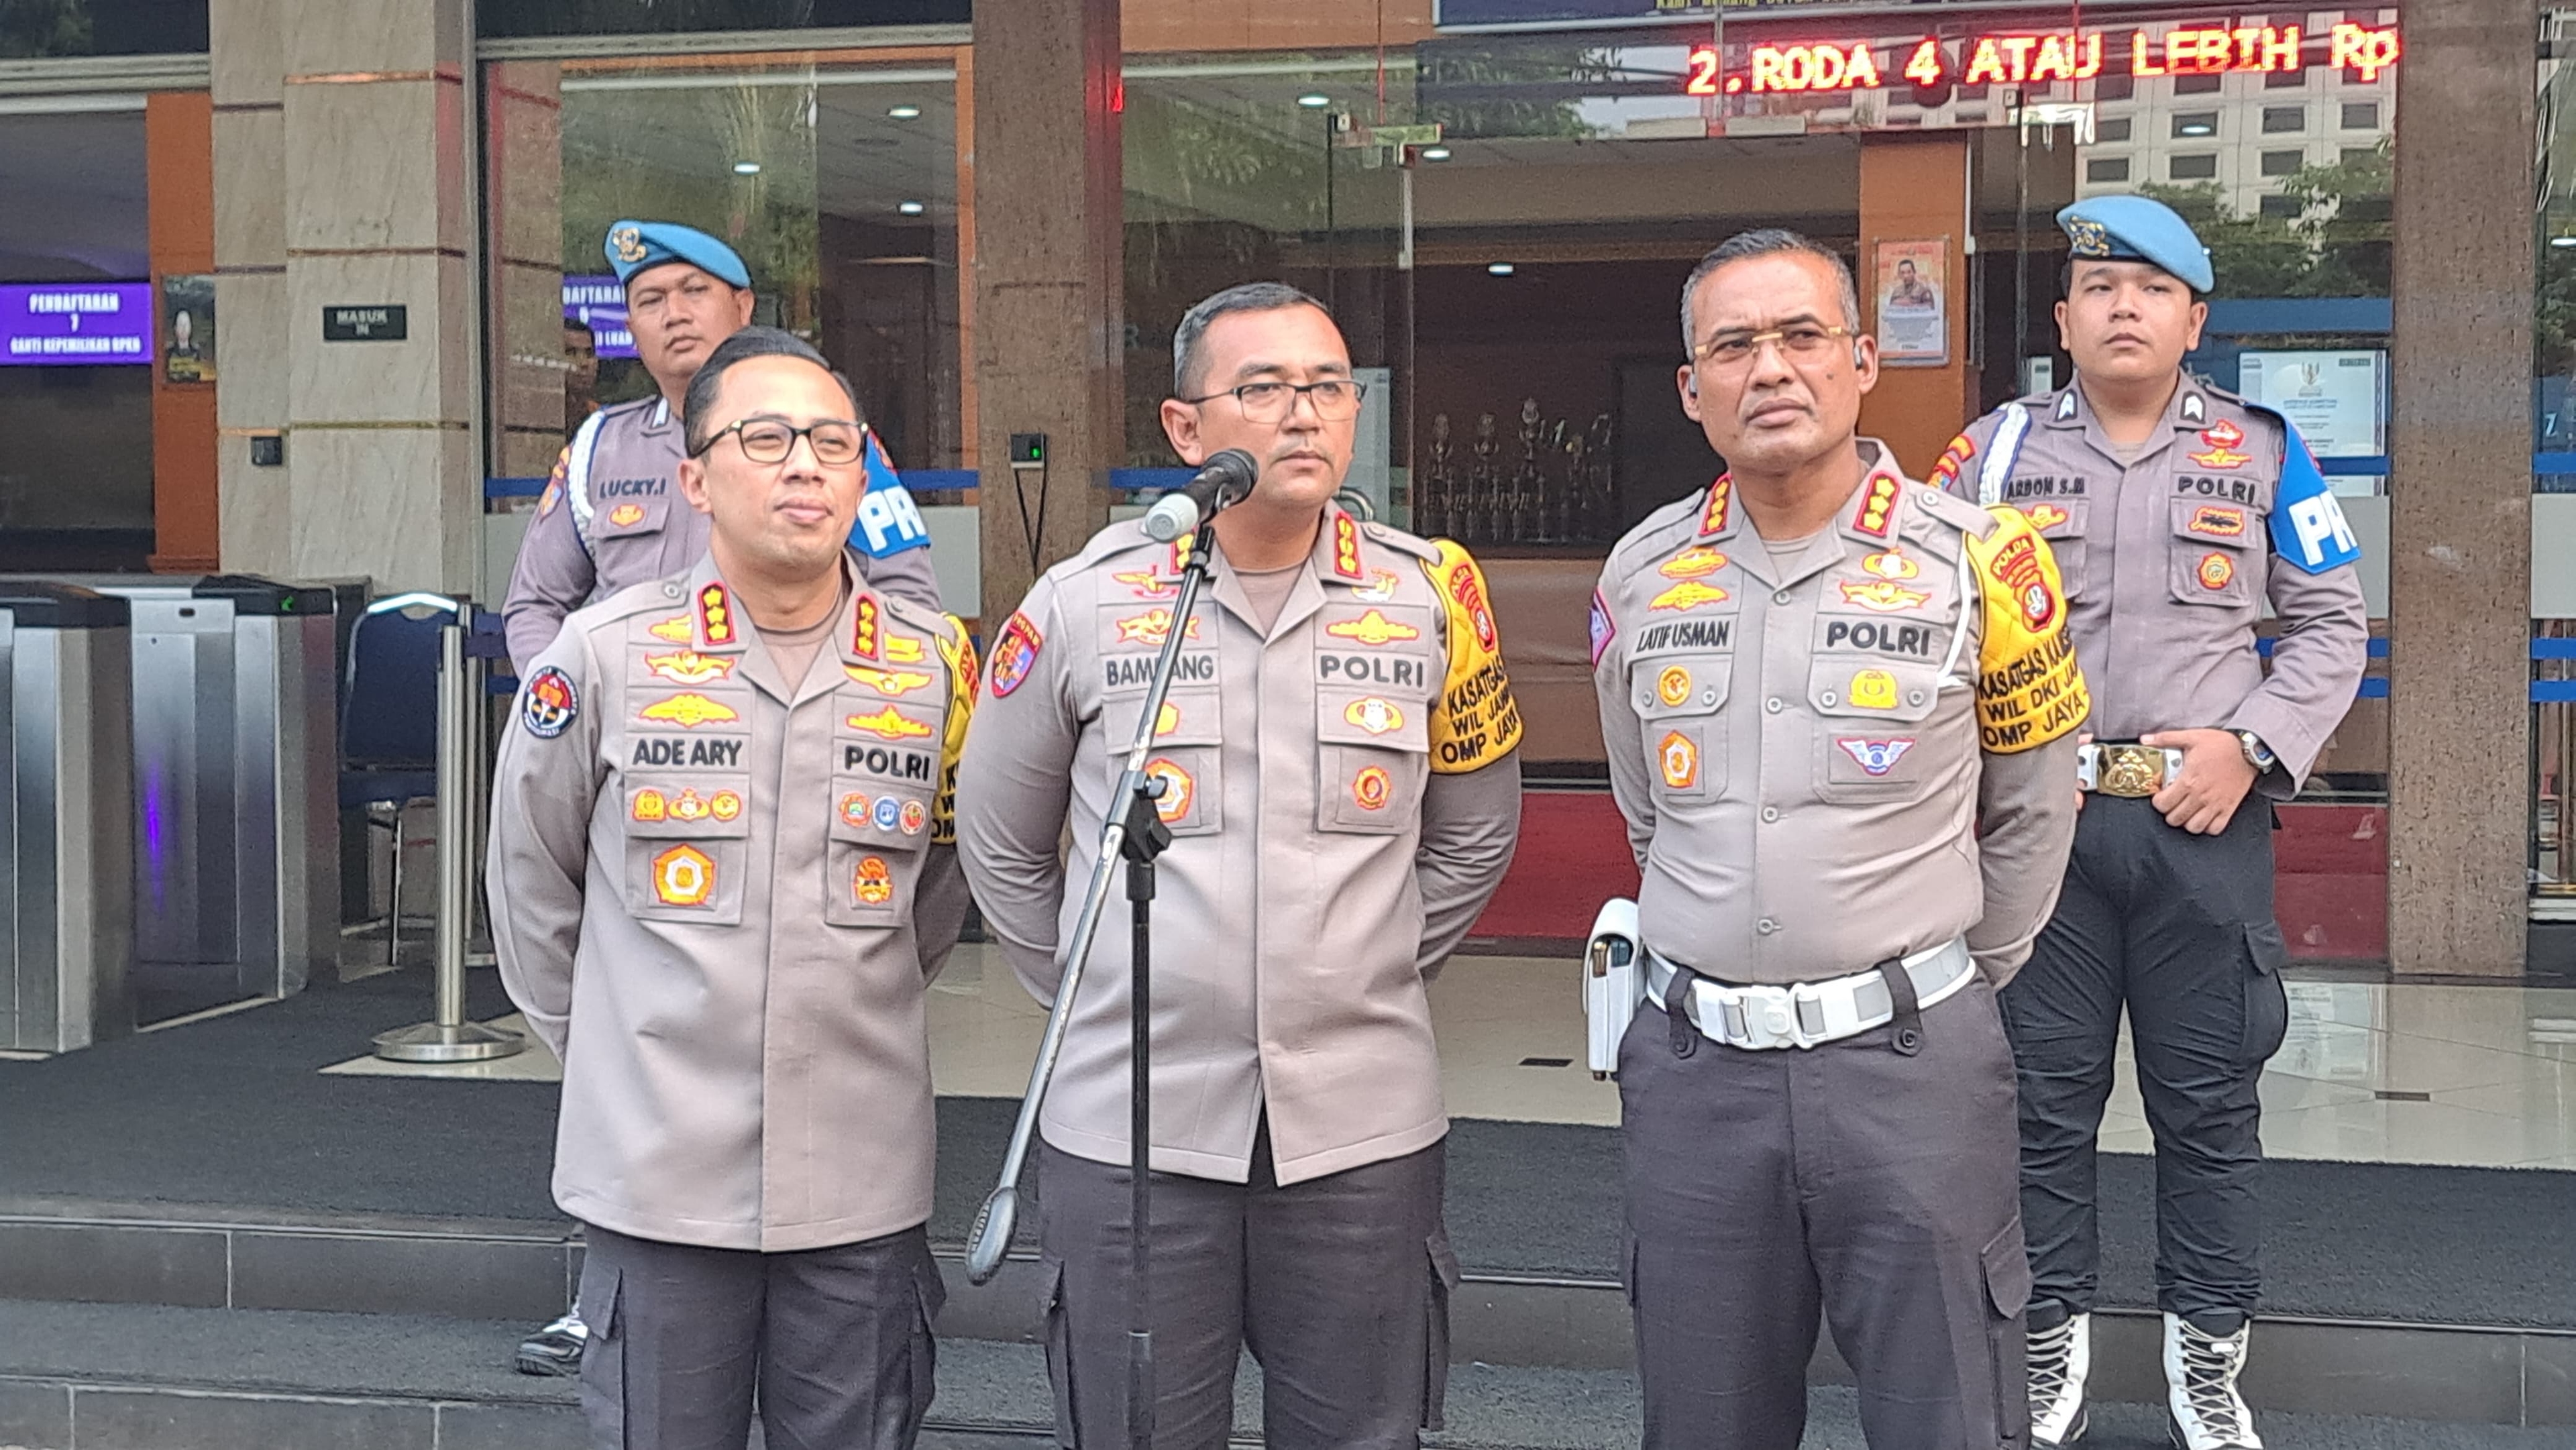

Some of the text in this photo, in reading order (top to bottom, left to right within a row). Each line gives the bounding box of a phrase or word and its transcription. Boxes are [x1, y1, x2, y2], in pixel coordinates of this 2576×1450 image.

[1905, 37, 1941, 86] 4
[1966, 34, 2102, 82] ATAU
[2132, 25, 2300, 76] LEBIH
[2331, 23, 2400, 81] Rp
[30, 292, 119, 313] PENDAFTARAN
[336, 309, 388, 325] MASUK
[355, 323, 369, 336] IN
[2178, 476, 2255, 504] POLRI
[1992, 537, 2031, 575] POLDA
[1635, 620, 1730, 653] LATIF USMAN
[1826, 621, 1930, 656] POLRI
[1106, 655, 1214, 686] BAMANG
[1320, 655, 1423, 688] POLRI
[1986, 700, 2027, 723] WIL
[2031, 676, 2059, 709] DKI
[1452, 712, 1484, 737] WIL
[1984, 690, 2085, 746] OMP JAYA
[632, 738, 742, 766] ADE ARY
[845, 745, 930, 782] POLRI
[1441, 732, 1487, 764] OMP
